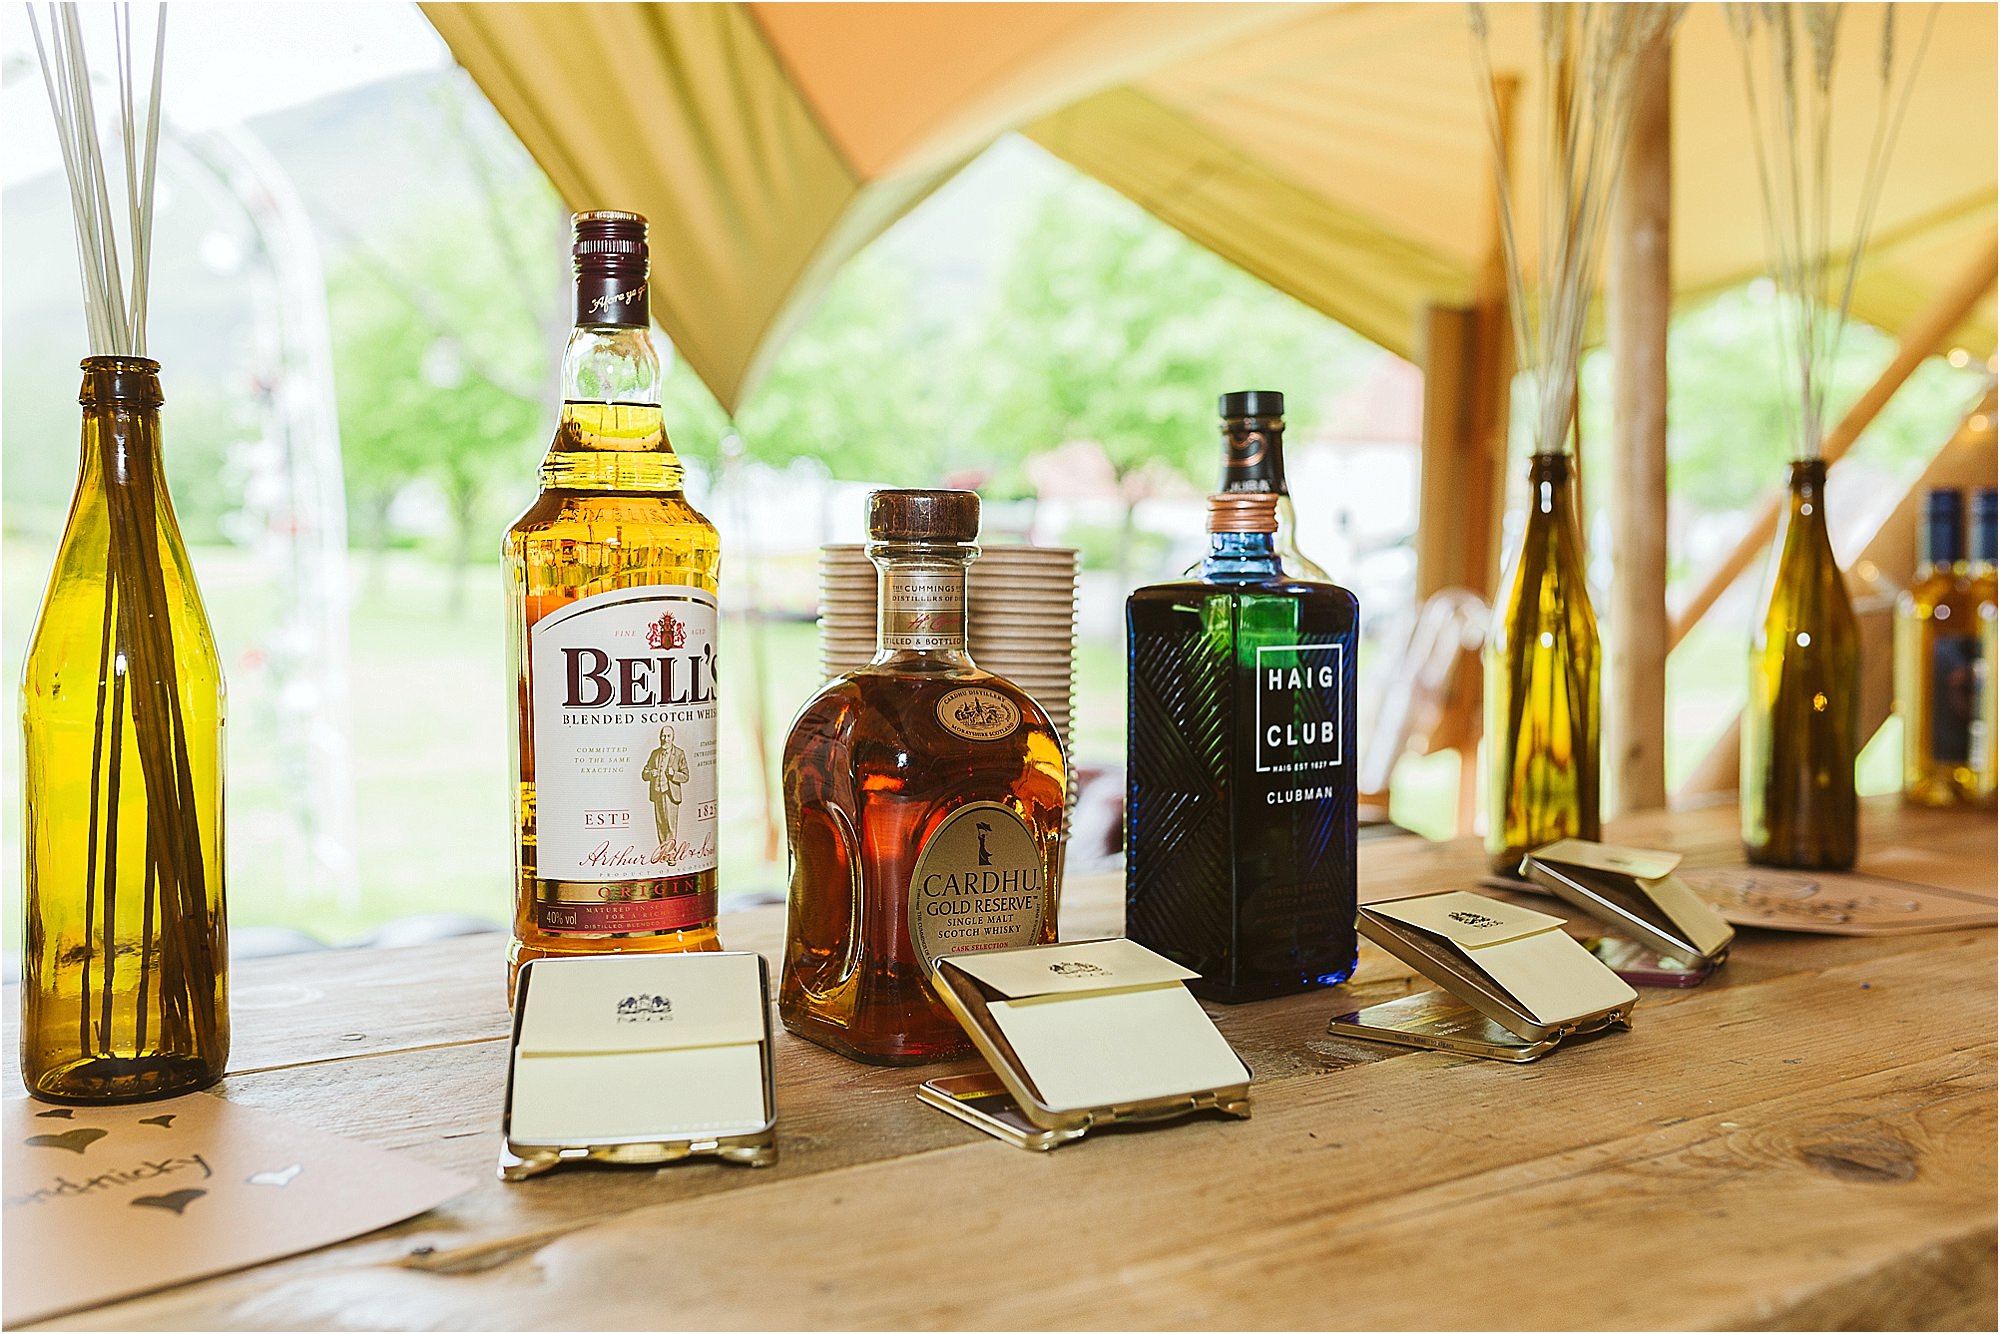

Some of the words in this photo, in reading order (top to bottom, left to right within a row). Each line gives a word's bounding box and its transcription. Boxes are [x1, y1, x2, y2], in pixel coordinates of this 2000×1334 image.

[904, 585, 955, 593] CUMMINGS
[915, 638, 921, 646] &
[925, 637, 962, 646] BOTTLED
[1268, 666, 1333, 691] HAIG
[562, 714, 635, 726] BLENDED
[640, 710, 694, 724] SCOTCH
[1266, 721, 1334, 747] CLUB
[1272, 764, 1292, 773] HAIG
[1293, 762, 1309, 772] EST
[1266, 786, 1333, 805] CLUBMAN
[585, 812, 630, 826] ESTD
[578, 840, 651, 868] Arthur
[922, 868, 1038, 898] CARDHU
[926, 900, 971, 916] GOLD
[974, 895, 1033, 914] RESERVE
[546, 911, 563, 925] 40%
[565, 911, 577, 925] vol
[947, 916, 984, 927] SINGLE
[986, 914, 1014, 925] MALT
[938, 928, 980, 939] SCOTCH
[983, 924, 1021, 937] WHISKY
[951, 945, 970, 953] CASK
[971, 941, 1009, 951] SELECTION
